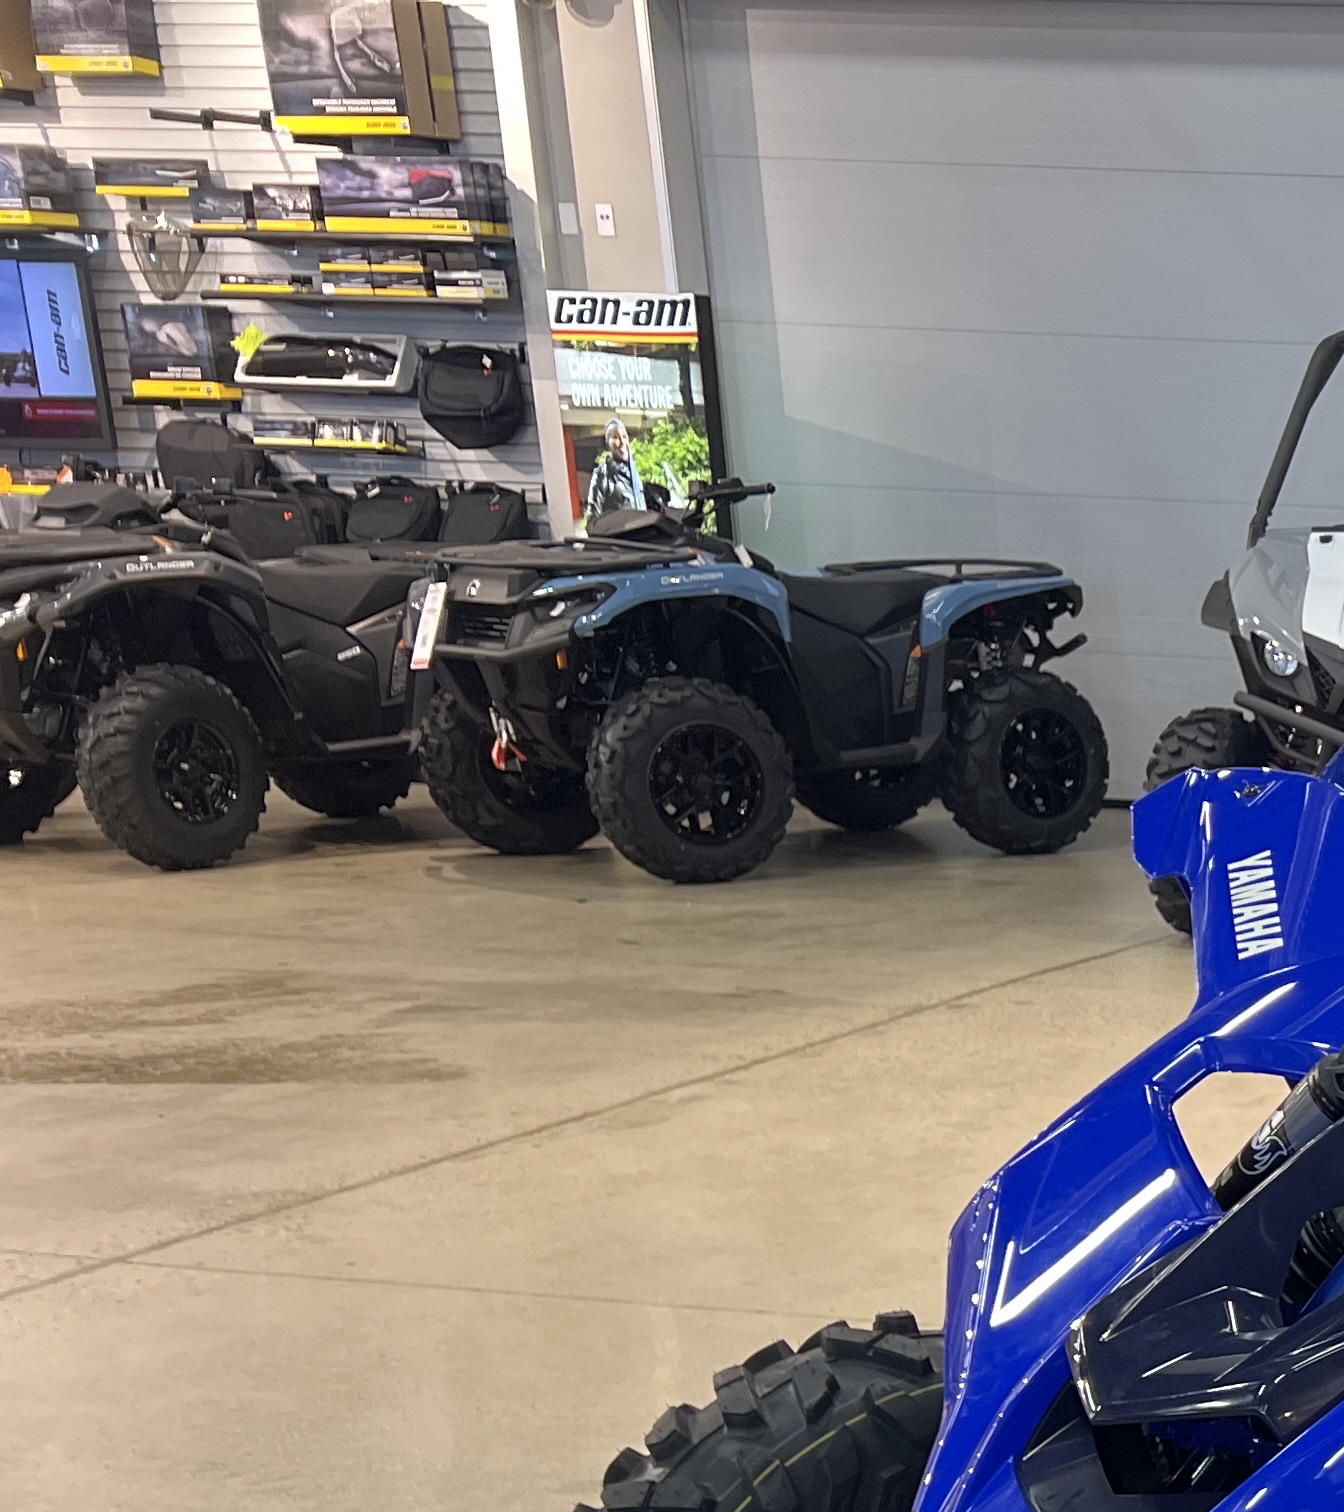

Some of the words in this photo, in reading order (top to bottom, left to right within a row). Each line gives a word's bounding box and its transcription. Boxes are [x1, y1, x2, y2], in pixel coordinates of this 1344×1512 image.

[554, 296, 690, 326] can-am
[568, 354, 617, 380] CHOOSE
[617, 356, 652, 381] YOUR
[571, 382, 602, 407] OWN
[603, 384, 675, 409] ADVENTURE
[1226, 849, 1285, 961] YAMAHA
